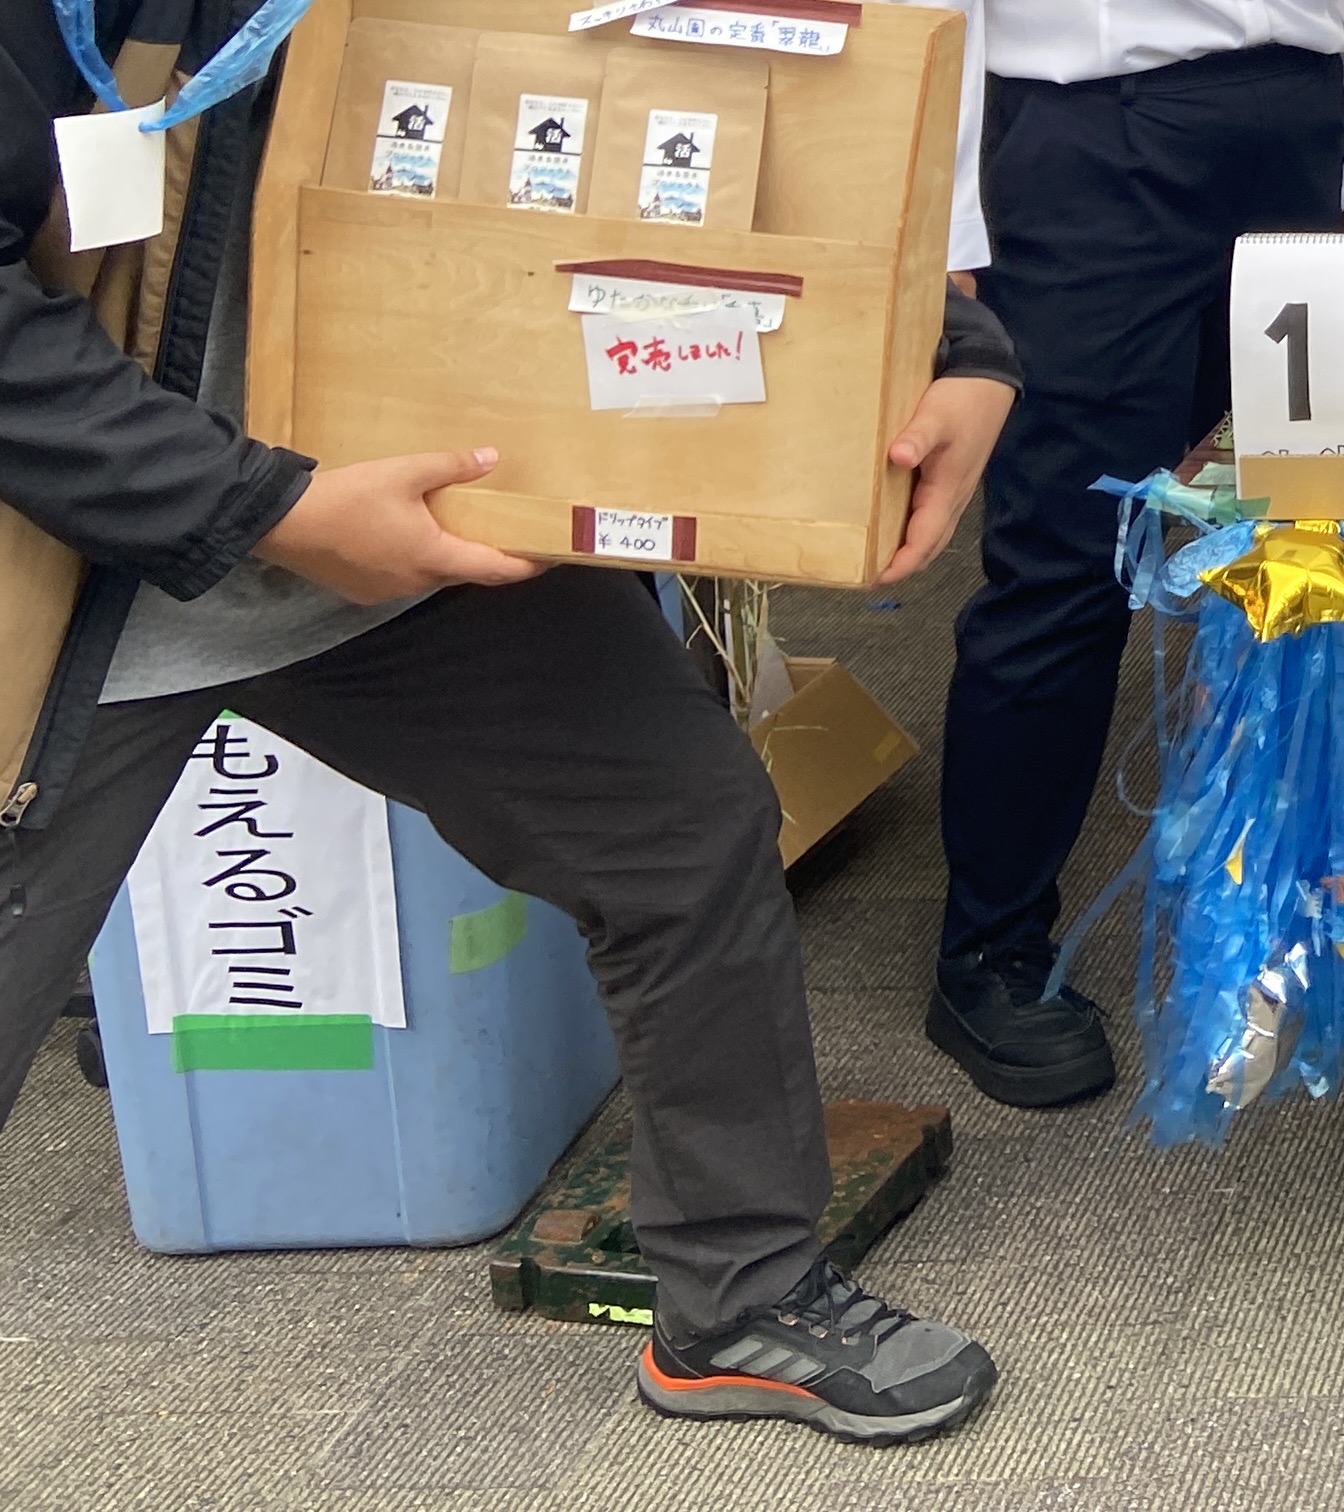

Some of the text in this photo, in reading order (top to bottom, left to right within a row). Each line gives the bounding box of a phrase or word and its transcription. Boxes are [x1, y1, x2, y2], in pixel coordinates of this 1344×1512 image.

[605, 330, 744, 376] 完売しました!
[189, 724, 314, 1009] もえるゴミ
